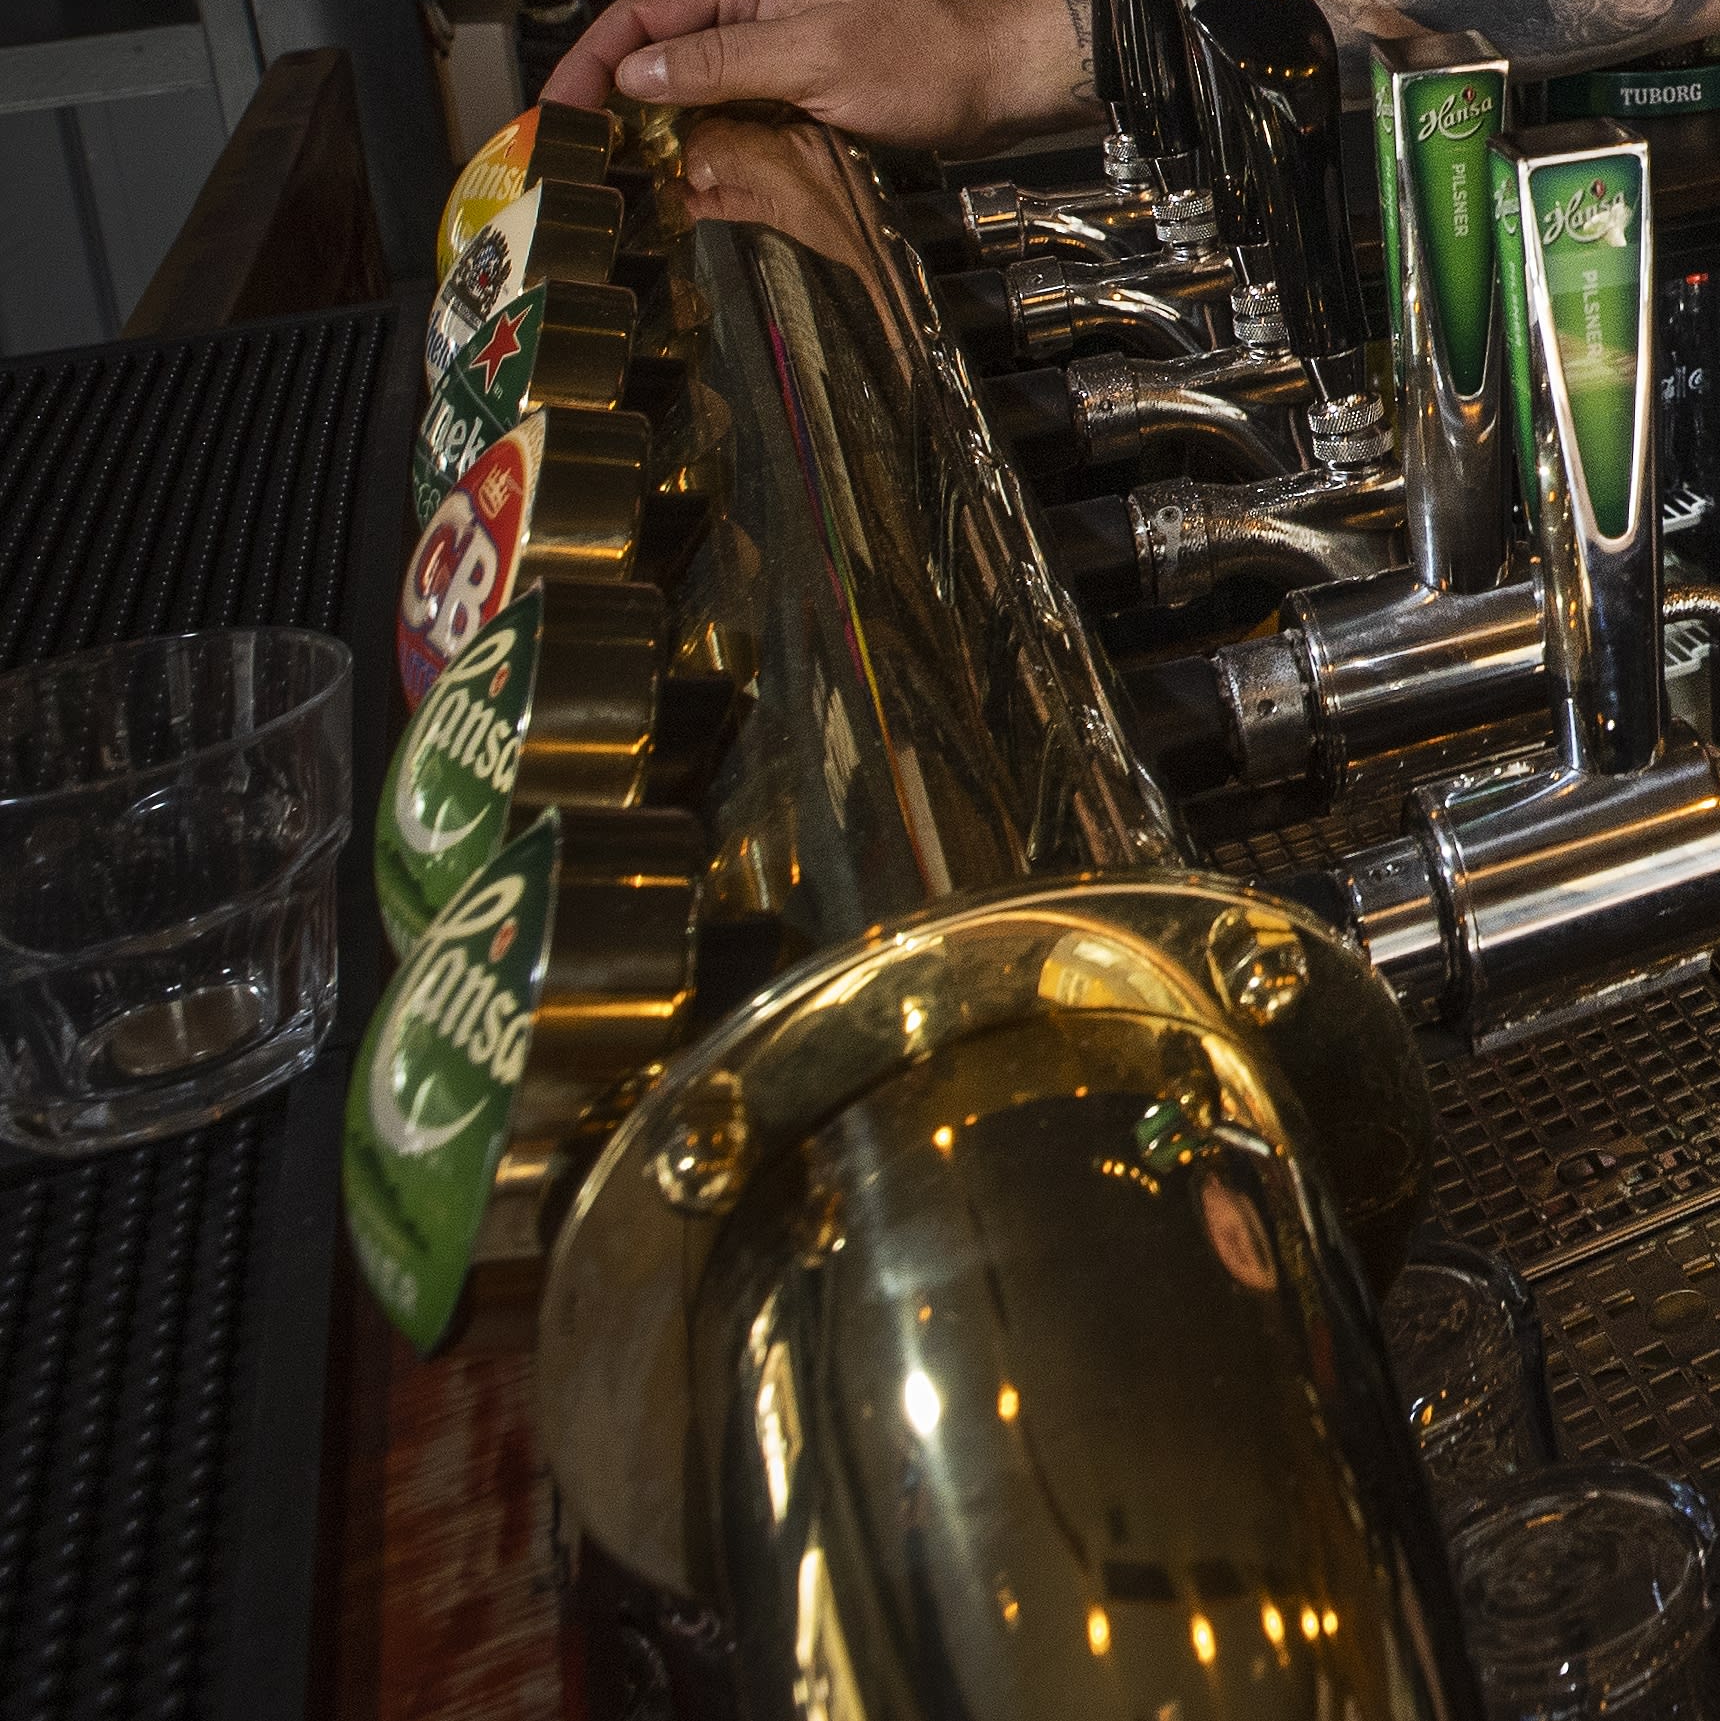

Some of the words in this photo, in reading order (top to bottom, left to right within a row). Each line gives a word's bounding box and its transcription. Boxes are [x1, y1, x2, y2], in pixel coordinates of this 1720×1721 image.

[1418, 93, 1493, 141] Hansa
[1620, 83, 1702, 106] TUBORG
[1451, 162, 1470, 237] PILSNER
[1543, 188, 1624, 245] Hansa
[1581, 269, 1607, 366] PILSNER
